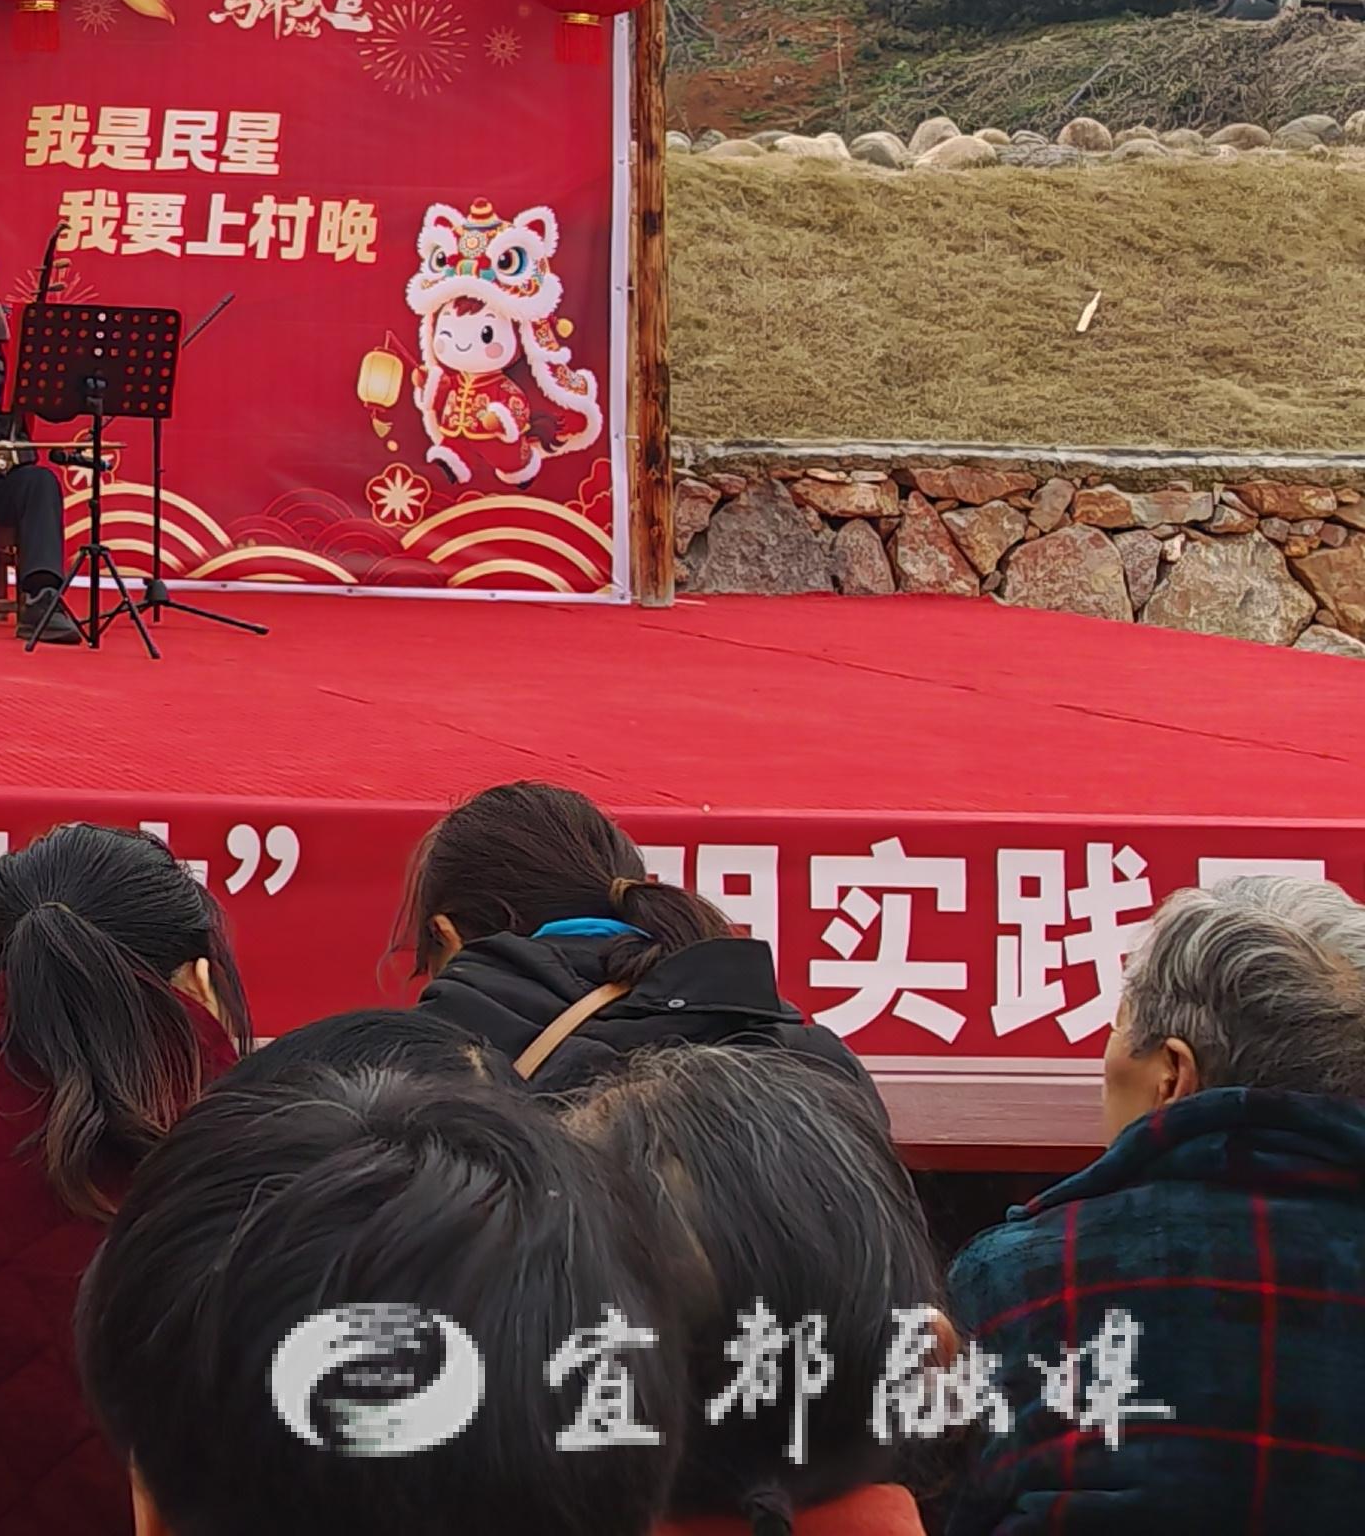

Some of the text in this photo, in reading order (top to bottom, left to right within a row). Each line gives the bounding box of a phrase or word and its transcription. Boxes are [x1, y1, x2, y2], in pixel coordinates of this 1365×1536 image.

[25, 104, 283, 177] 我是民星
[56, 188, 380, 267] 我要上村晚
